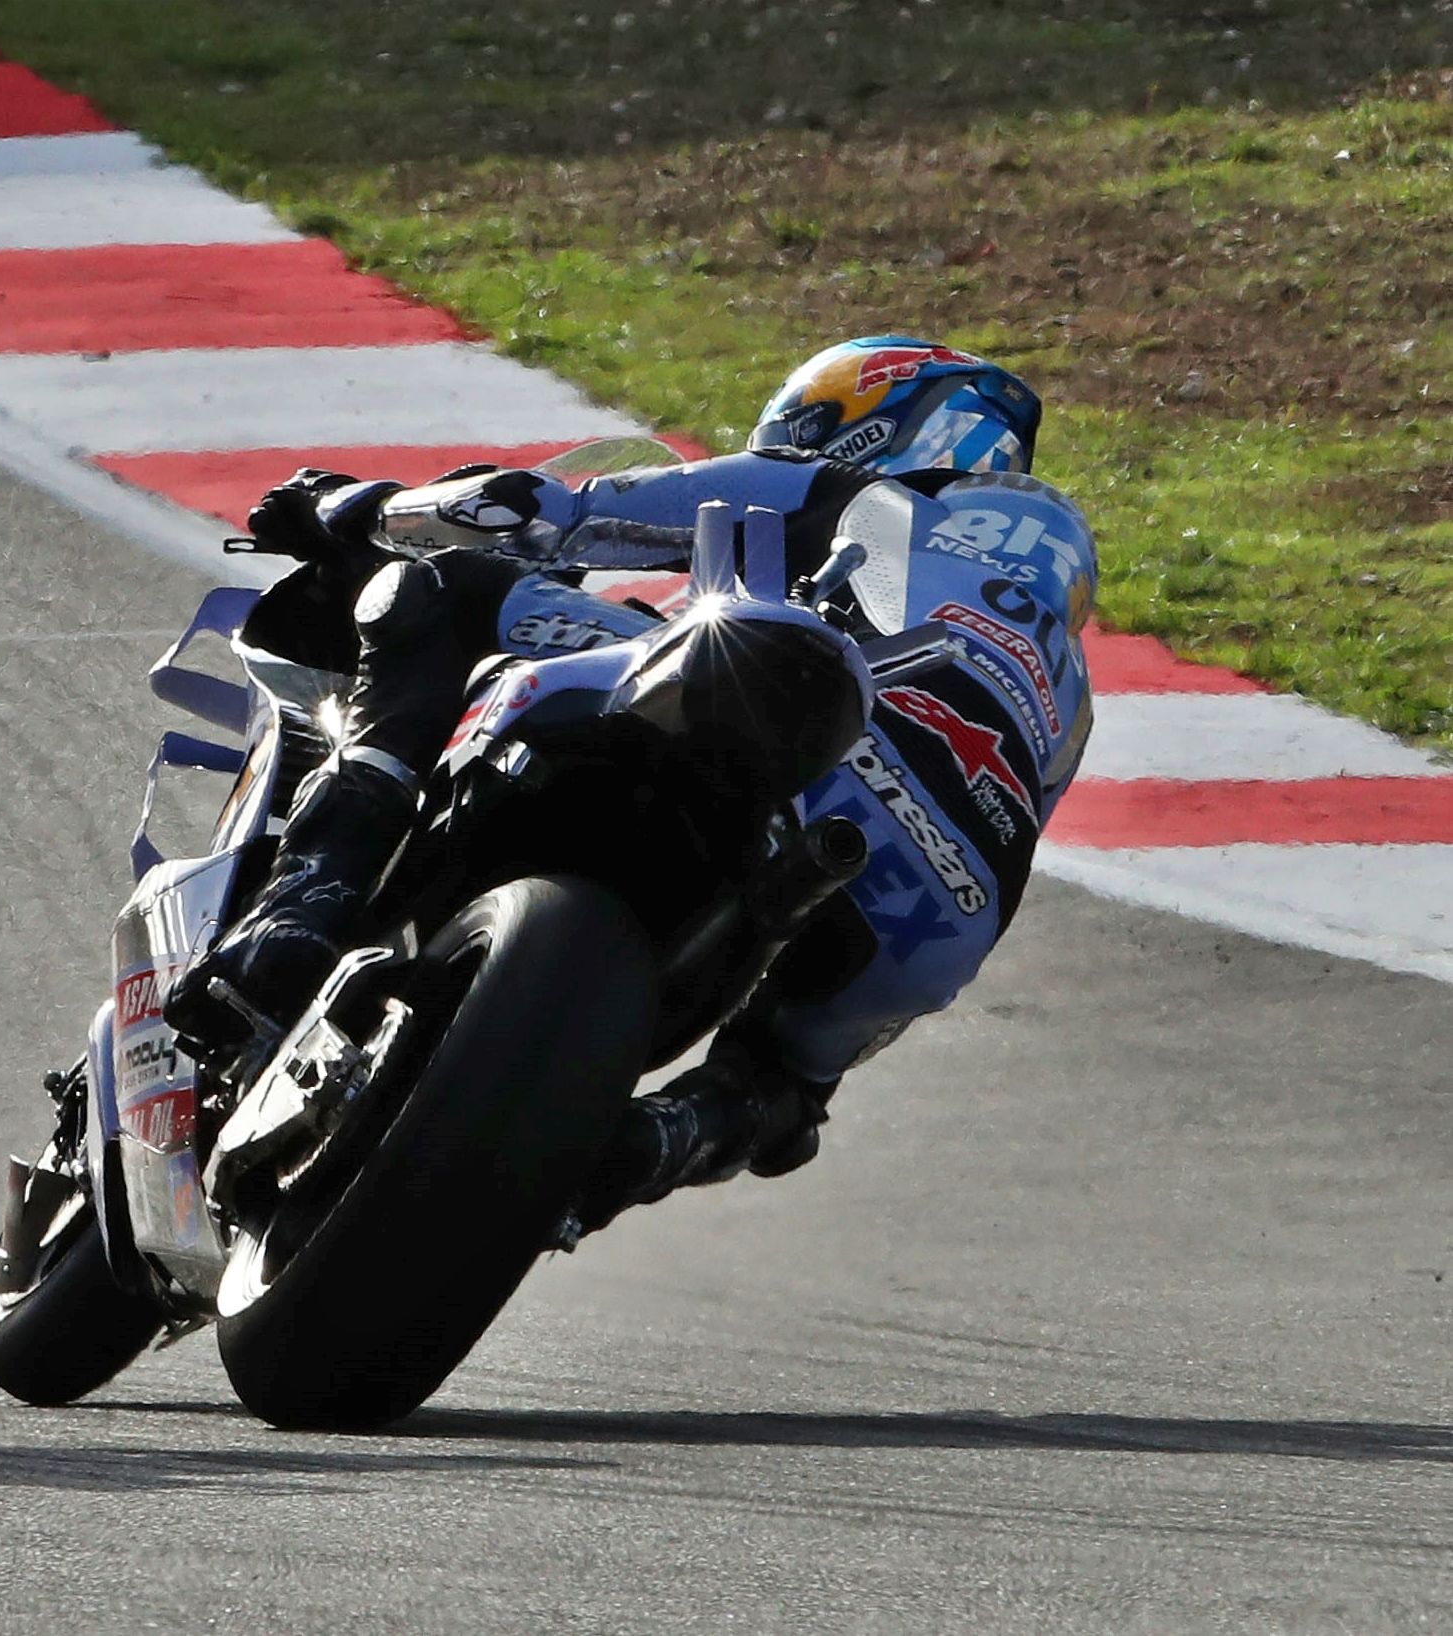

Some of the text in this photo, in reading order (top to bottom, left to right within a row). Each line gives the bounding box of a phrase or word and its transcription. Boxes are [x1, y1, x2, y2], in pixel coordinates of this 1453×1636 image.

[925, 535, 1040, 584] NEWS
[944, 606, 1046, 684] FEDERAL
[1039, 687, 1059, 729] OIL
[971, 652, 1047, 756] MICHELIN
